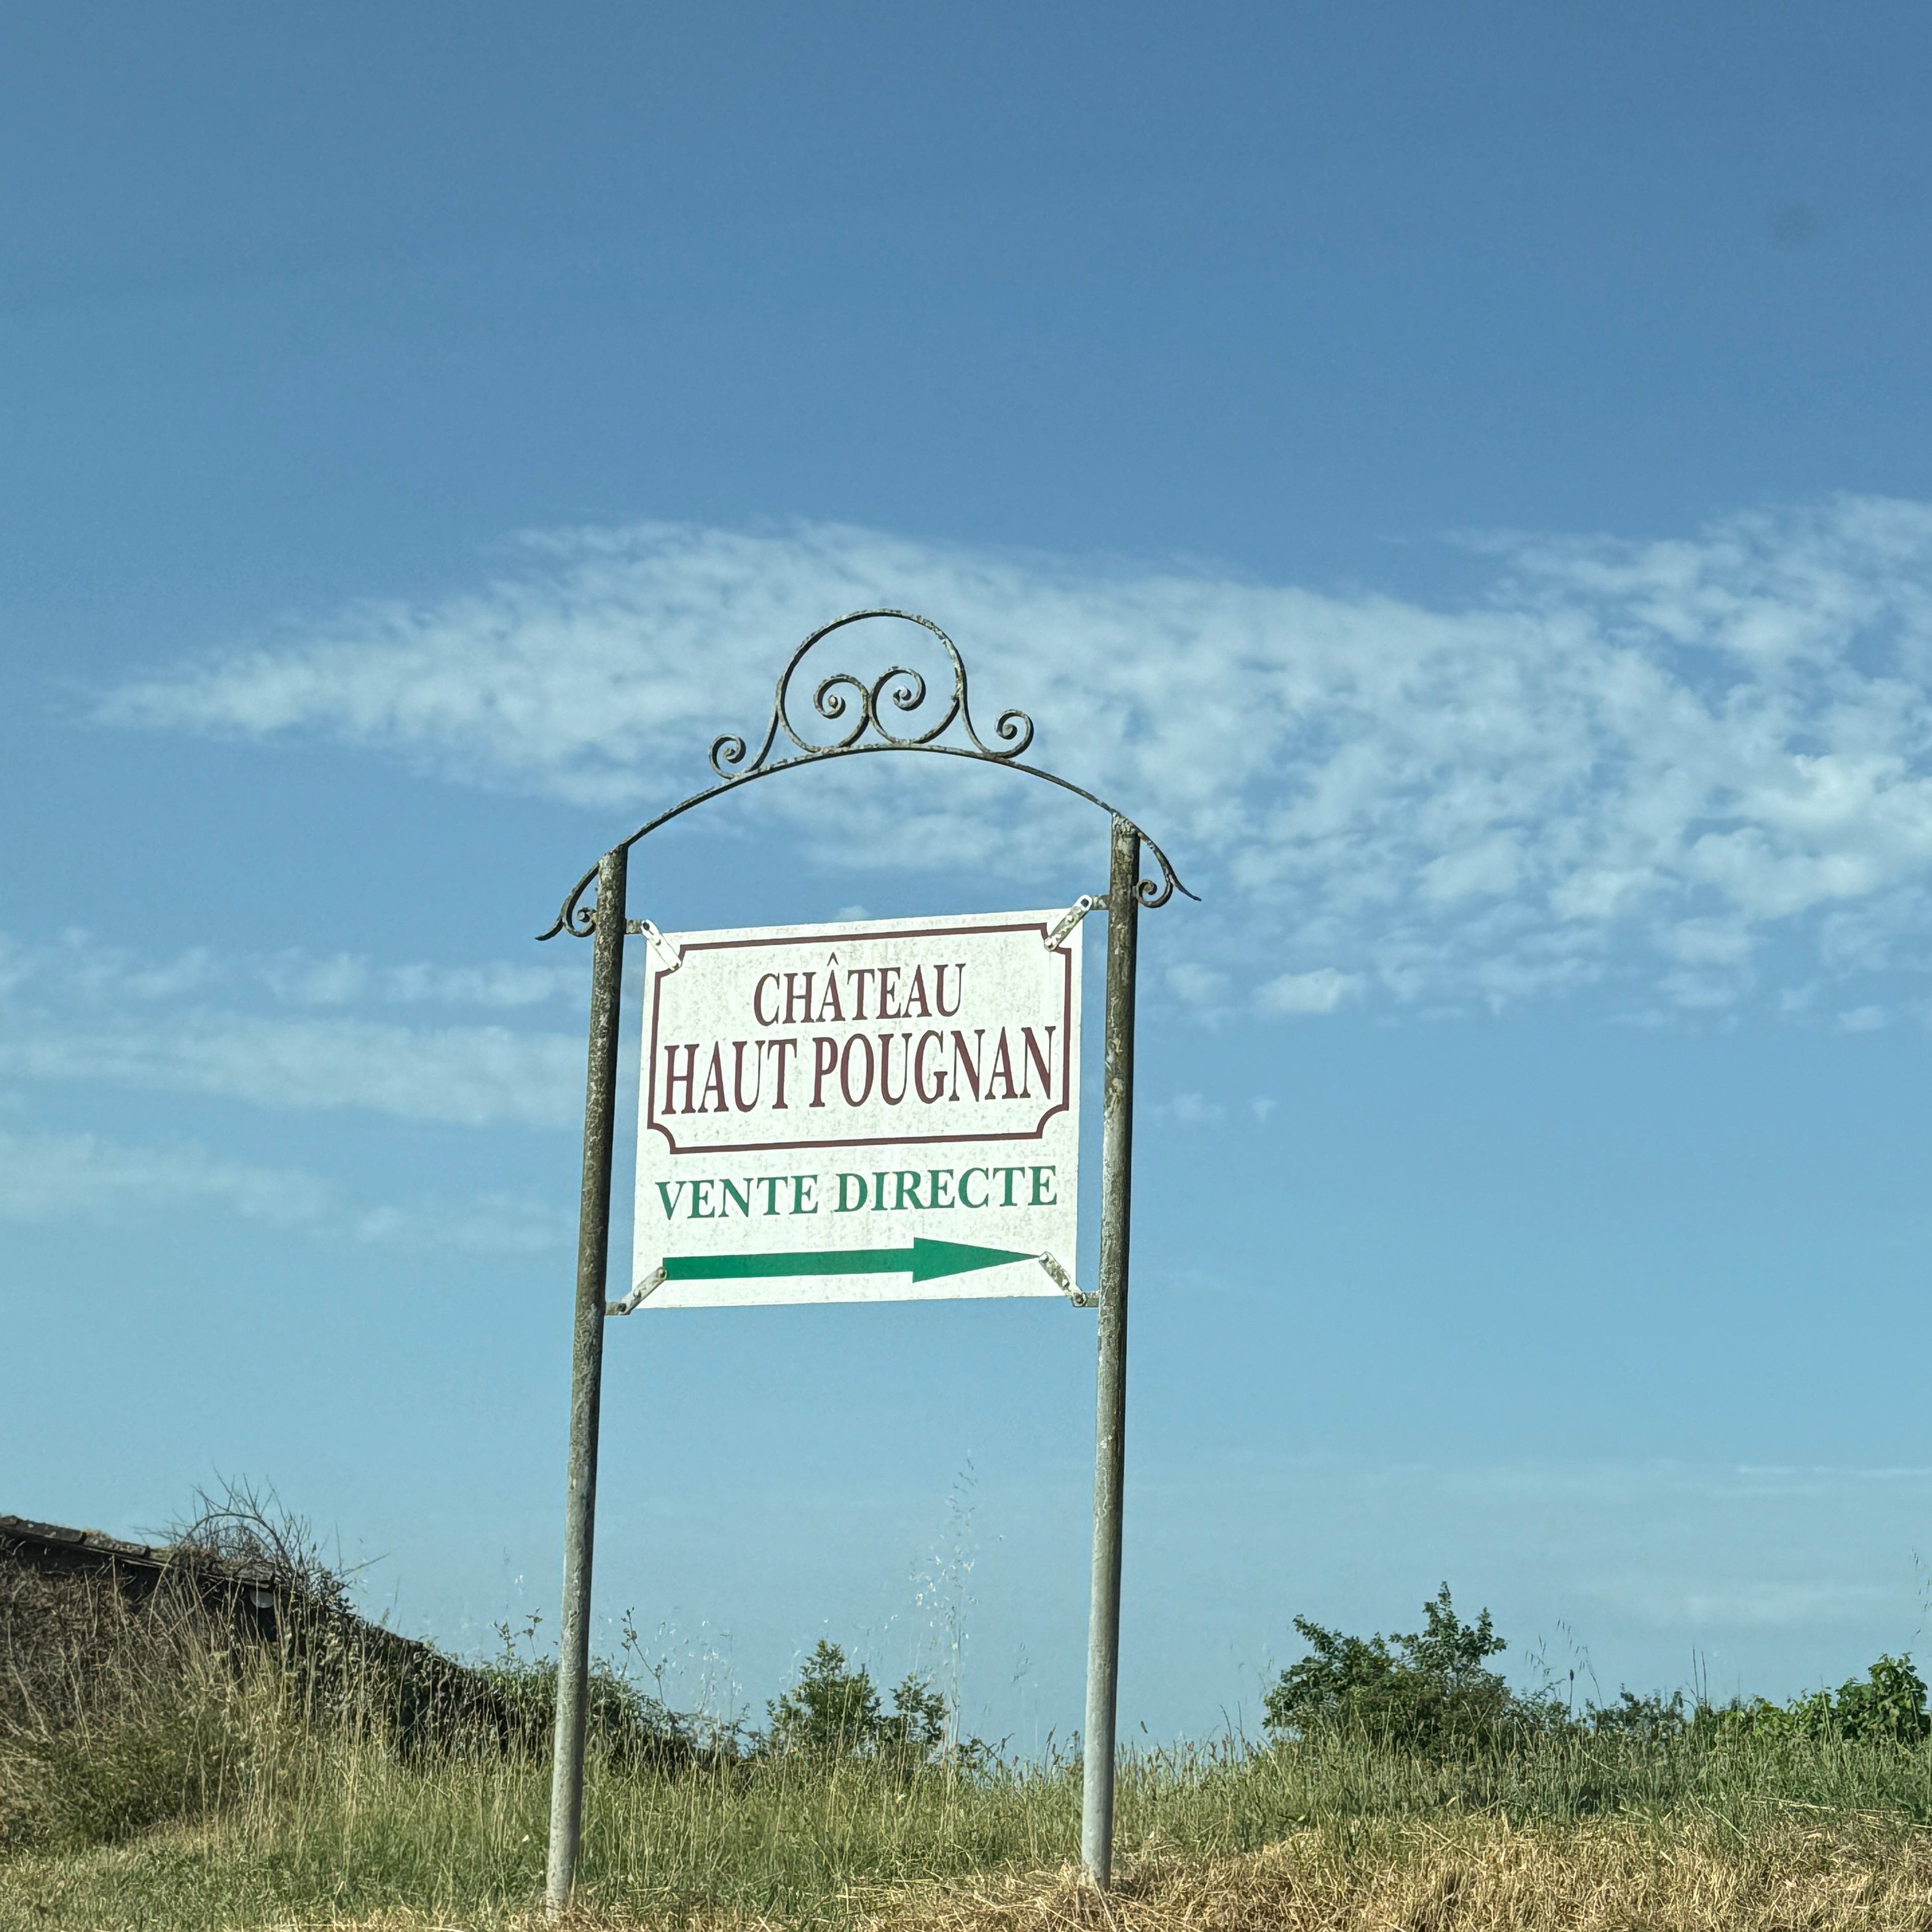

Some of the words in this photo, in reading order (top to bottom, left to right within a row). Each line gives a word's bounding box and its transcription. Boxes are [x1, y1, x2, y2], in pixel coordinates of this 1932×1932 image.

[753, 951, 966, 1027] CHÂTEAU
[661, 1038, 798, 1115] HAUT
[809, 1025, 1056, 1108] POUGNAN
[655, 1174, 819, 1220] VENTE
[834, 1165, 1058, 1213] DIRECTE
